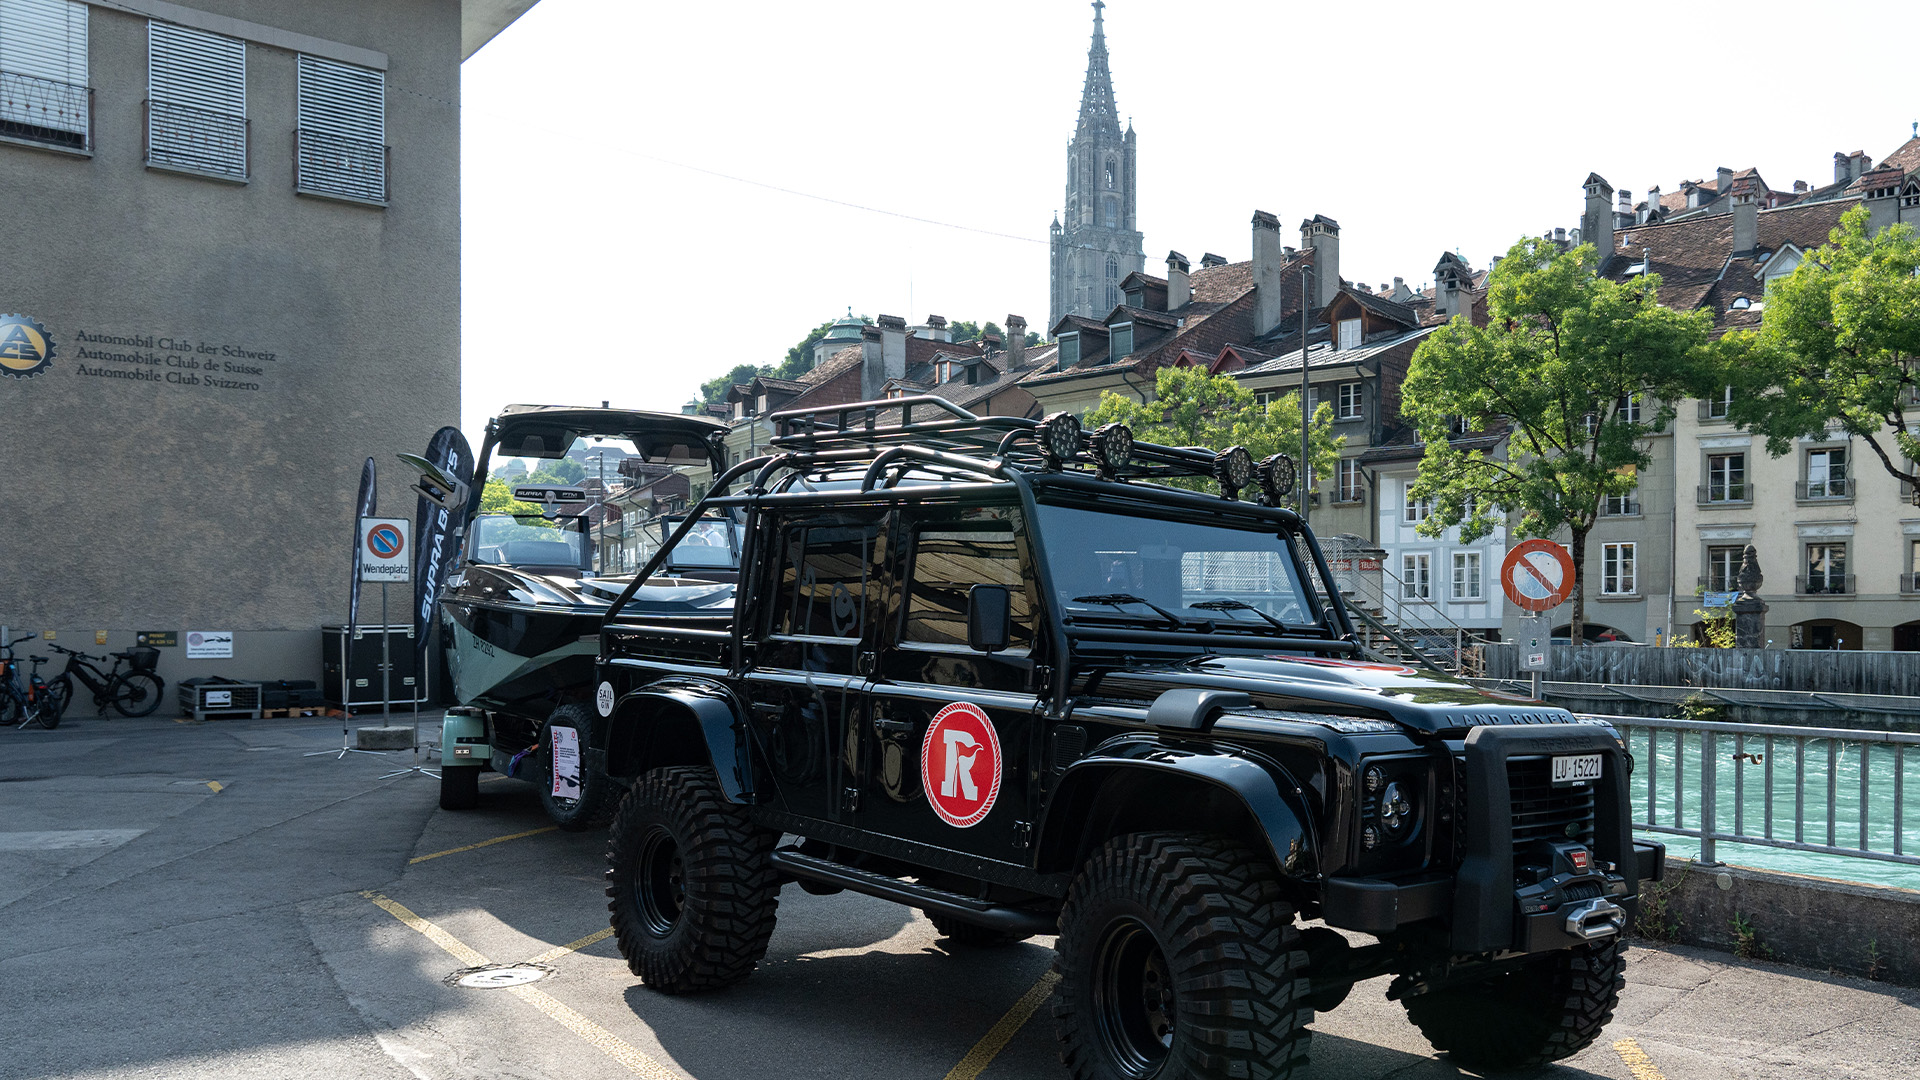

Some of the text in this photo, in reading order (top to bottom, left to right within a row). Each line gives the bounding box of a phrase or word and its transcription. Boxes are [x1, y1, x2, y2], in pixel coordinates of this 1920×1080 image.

[76, 330, 276, 361] Automobil Club der Schweiz
[76, 347, 263, 376] Automobile Club de Suisse
[76, 364, 259, 391] Automobile Club Svizzero
[363, 563, 408, 576] Wendeplatz
[421, 533, 445, 623] SUPRA
[599, 689, 612, 700] SAIL
[1446, 713, 1569, 727] LAND ROVER
[1530, 736, 1594, 750] DEFENDER
